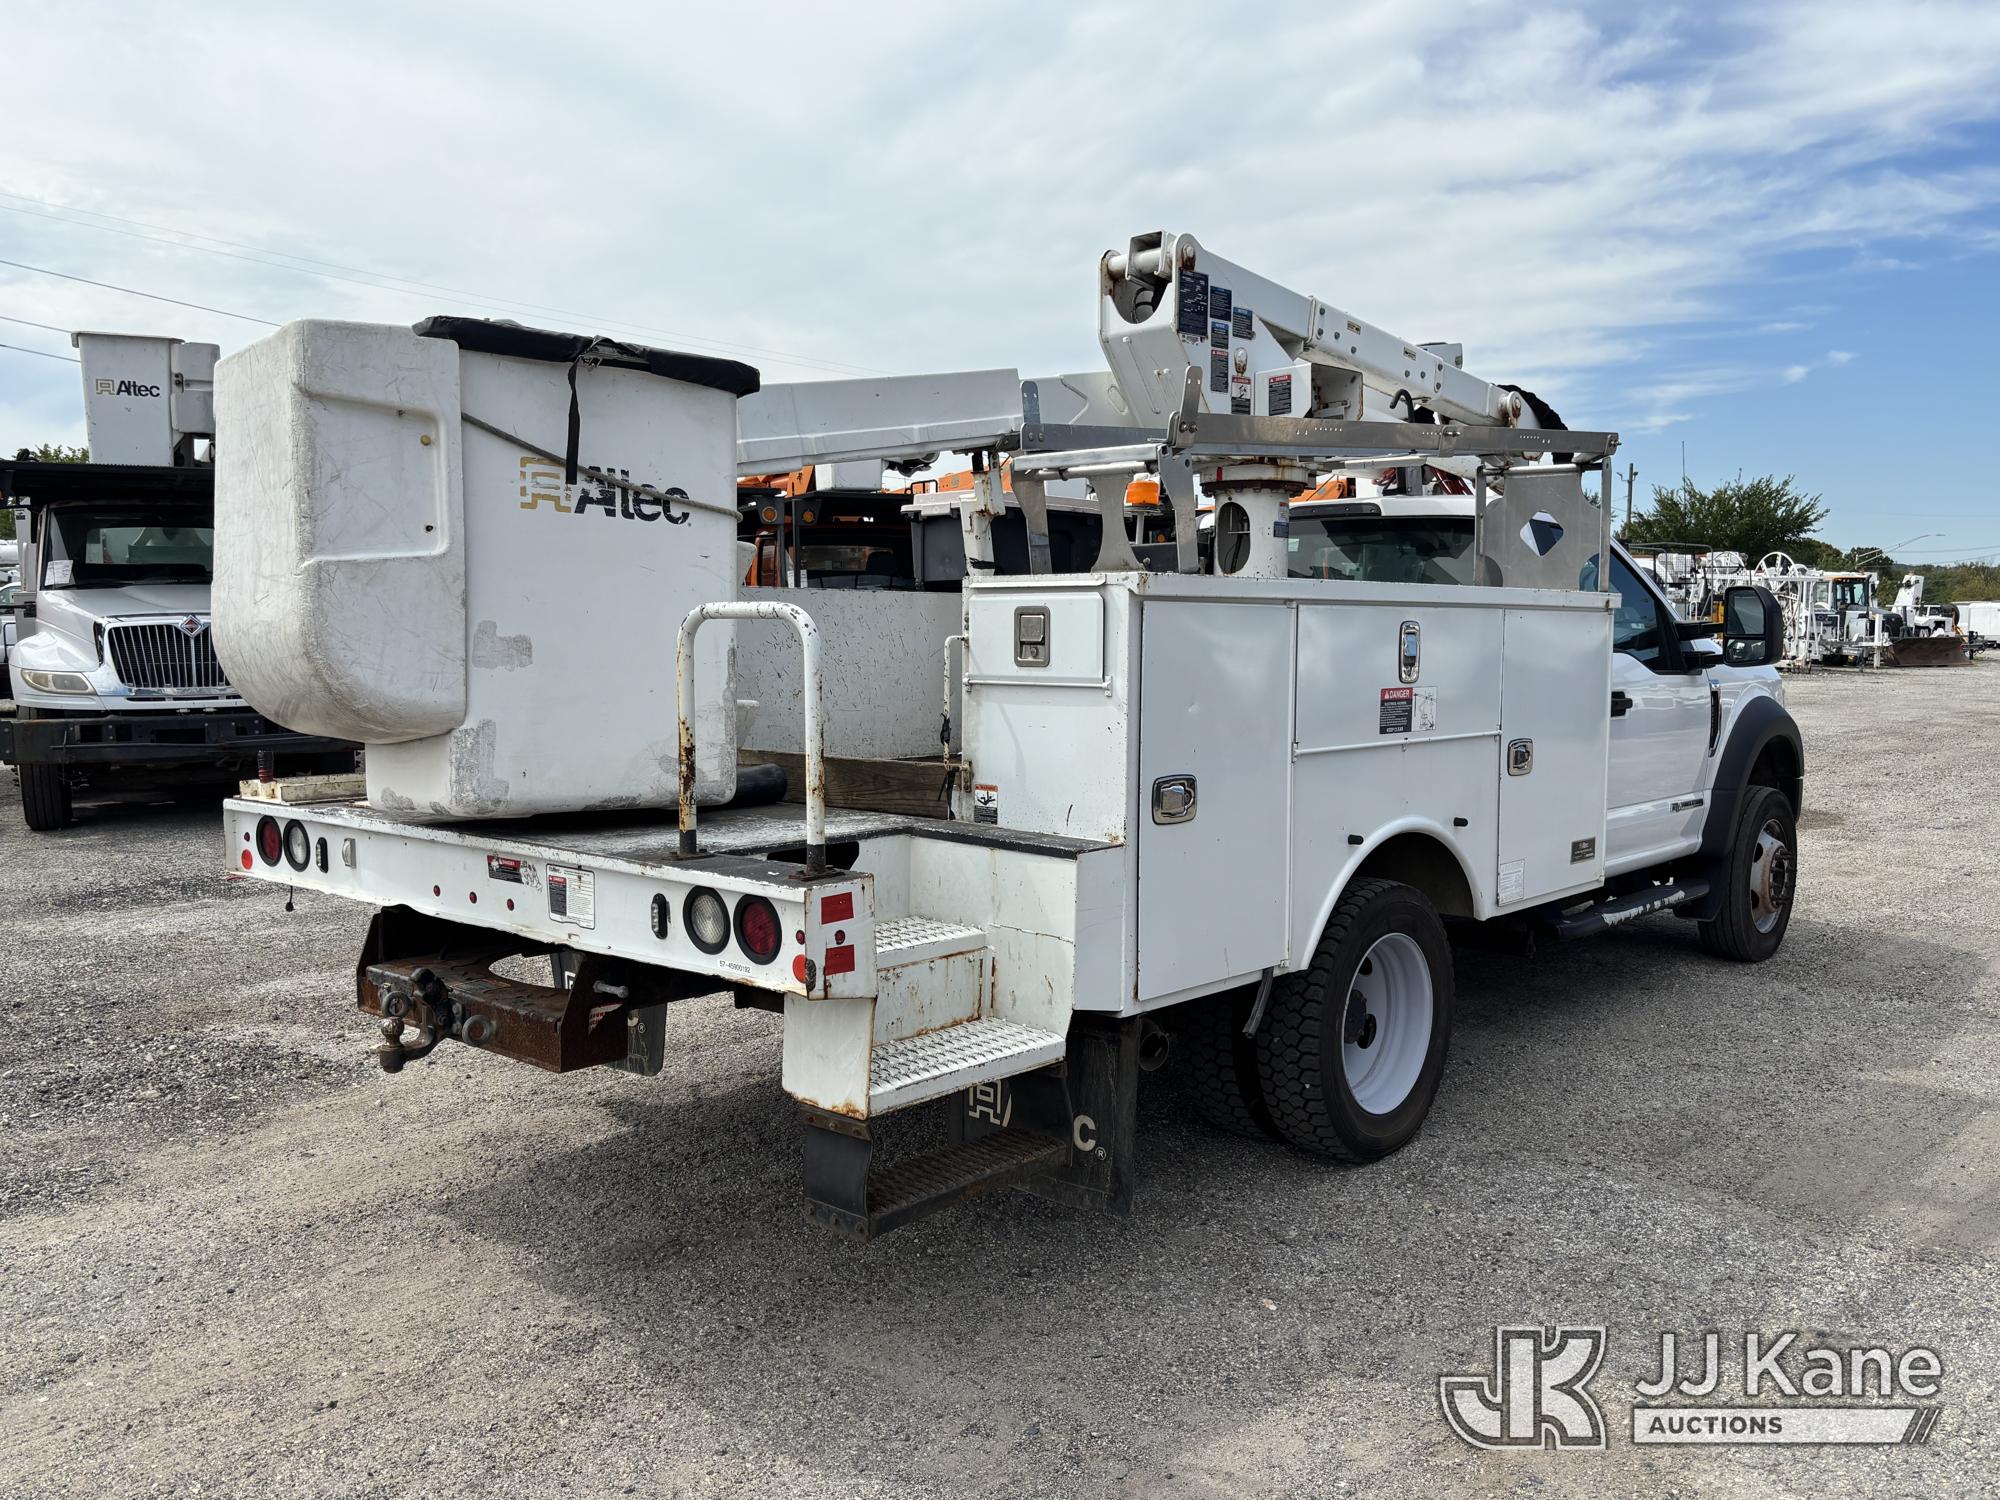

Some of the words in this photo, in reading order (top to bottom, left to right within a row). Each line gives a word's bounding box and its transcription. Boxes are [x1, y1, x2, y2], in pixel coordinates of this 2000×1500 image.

[116, 380, 160, 397] Altec
[574, 465, 690, 525] Altec
[1390, 690, 1410, 699] DANGER
